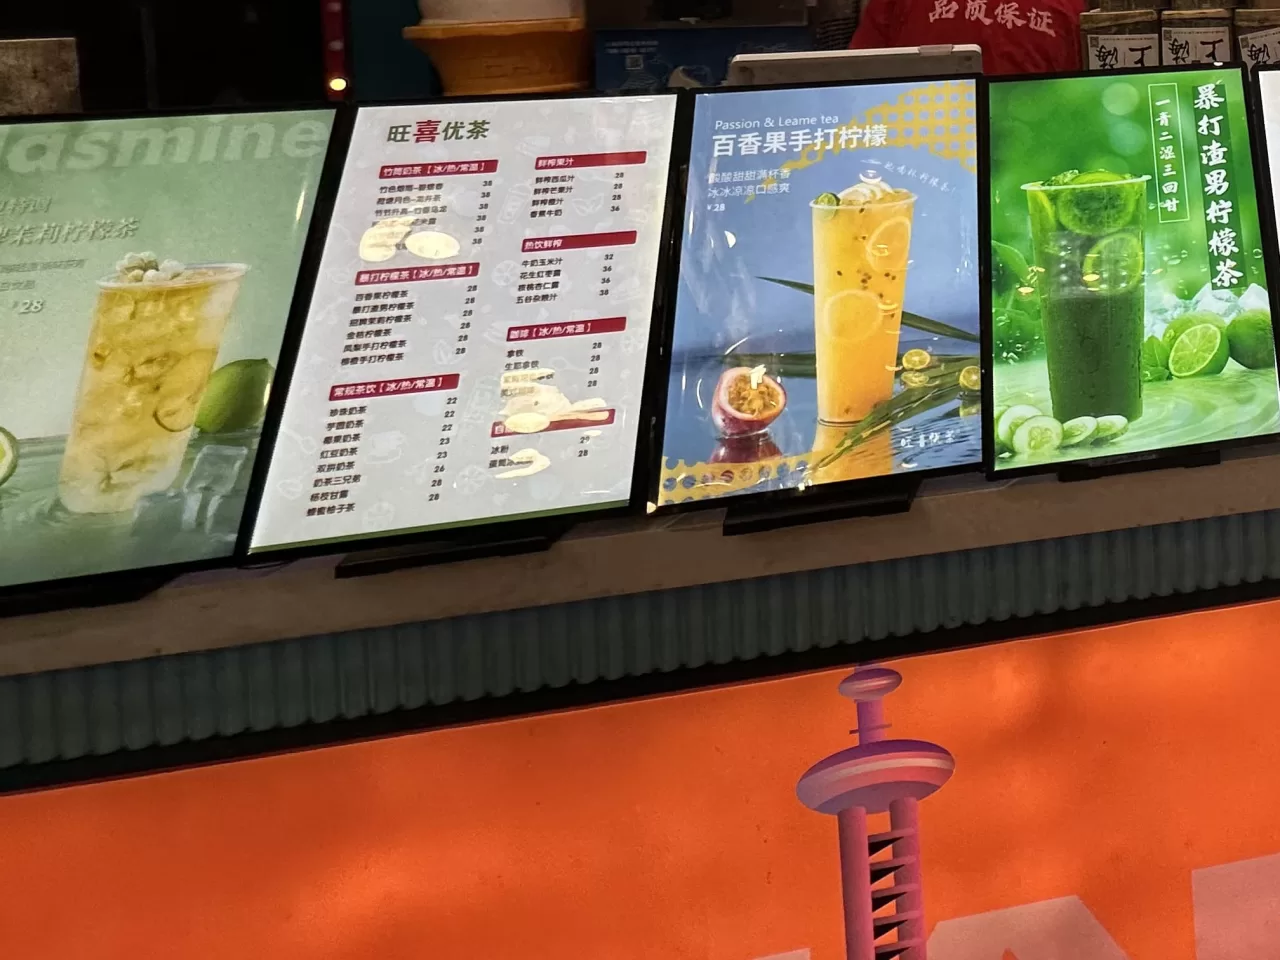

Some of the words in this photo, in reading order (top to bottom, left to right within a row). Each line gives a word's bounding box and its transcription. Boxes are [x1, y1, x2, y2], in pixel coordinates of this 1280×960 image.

[385, 117, 491, 144] 旺喜优茶
[715, 118, 760, 130] Passion
[765, 117, 775, 127] &
[779, 116, 817, 127] Leame
[821, 114, 839, 124] tea
[0, 118, 328, 173] asmine
[712, 124, 888, 157] 百香果手打柠檬
[707, 183, 790, 198] 冰冰凉凉口感爽
[1194, 82, 1244, 287] 暴打渣男柠檬茶
[436, 451, 447, 459] 23
[430, 479, 442, 487] 28
